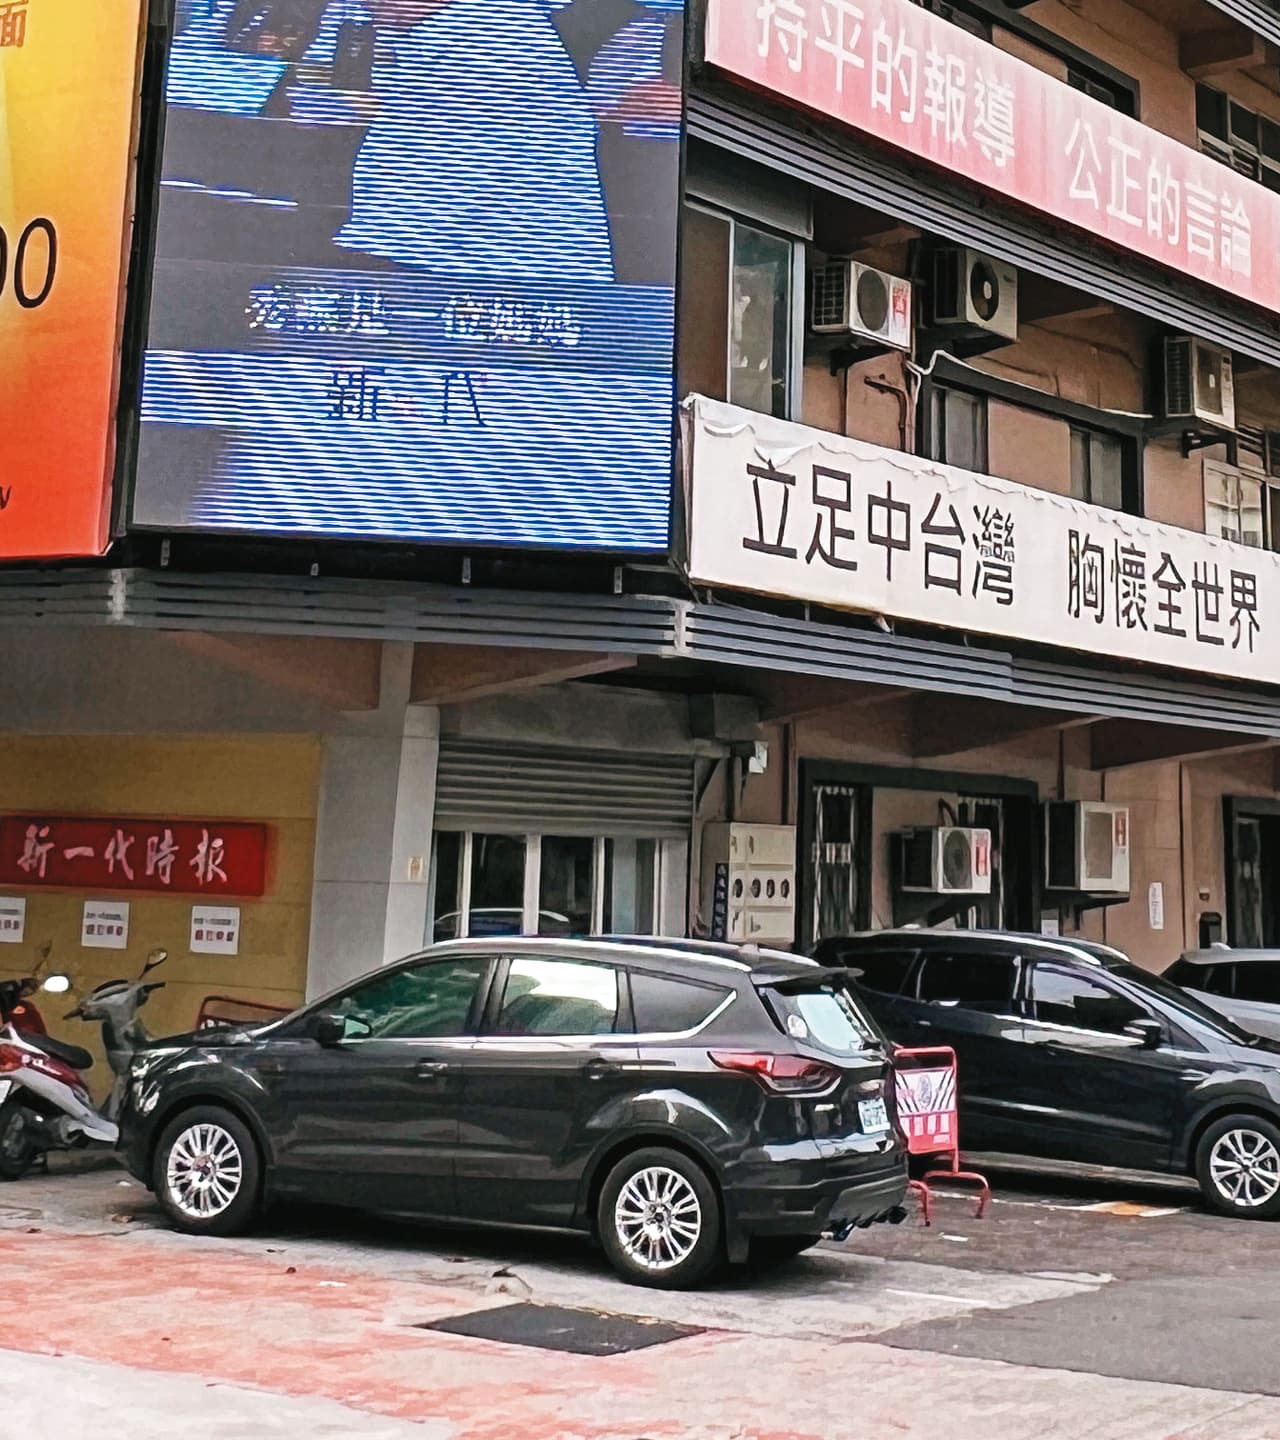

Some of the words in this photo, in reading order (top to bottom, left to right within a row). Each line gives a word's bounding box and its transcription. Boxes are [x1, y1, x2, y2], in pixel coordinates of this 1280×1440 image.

[1065, 117, 1252, 279] 公正的言論
[742, 458, 1016, 607] 立足中台灣
[1067, 528, 1261, 653] 胸懷全世界
